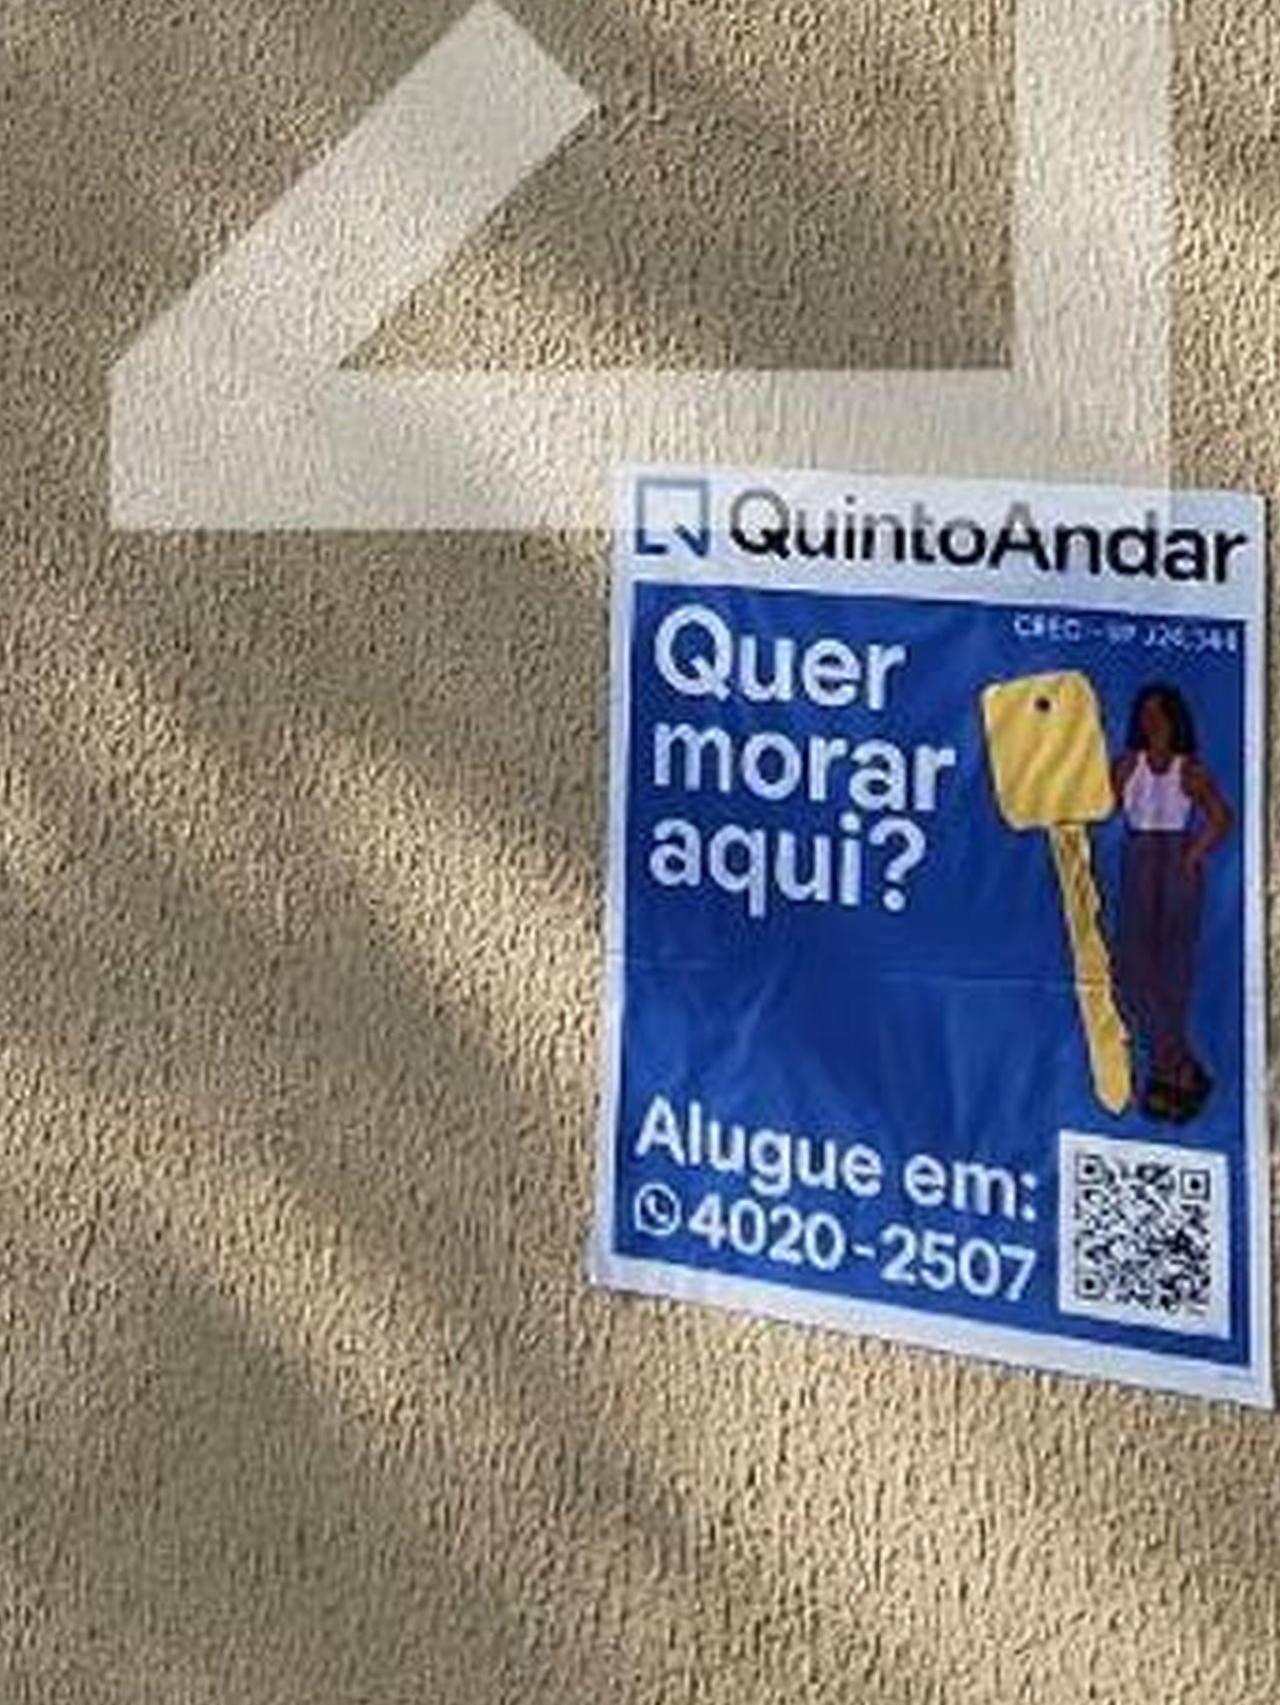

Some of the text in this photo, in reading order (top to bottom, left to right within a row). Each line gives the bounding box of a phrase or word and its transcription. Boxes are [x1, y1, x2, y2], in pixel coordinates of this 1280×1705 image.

[730, 487, 1248, 583] QuintoAndar
[654, 603, 907, 710] Quer
[654, 722, 955, 811] morar
[648, 813, 926, 918] aqui?
[634, 1095, 1039, 1222] Alugue em:
[687, 1199, 1038, 1301] 4020-2507
